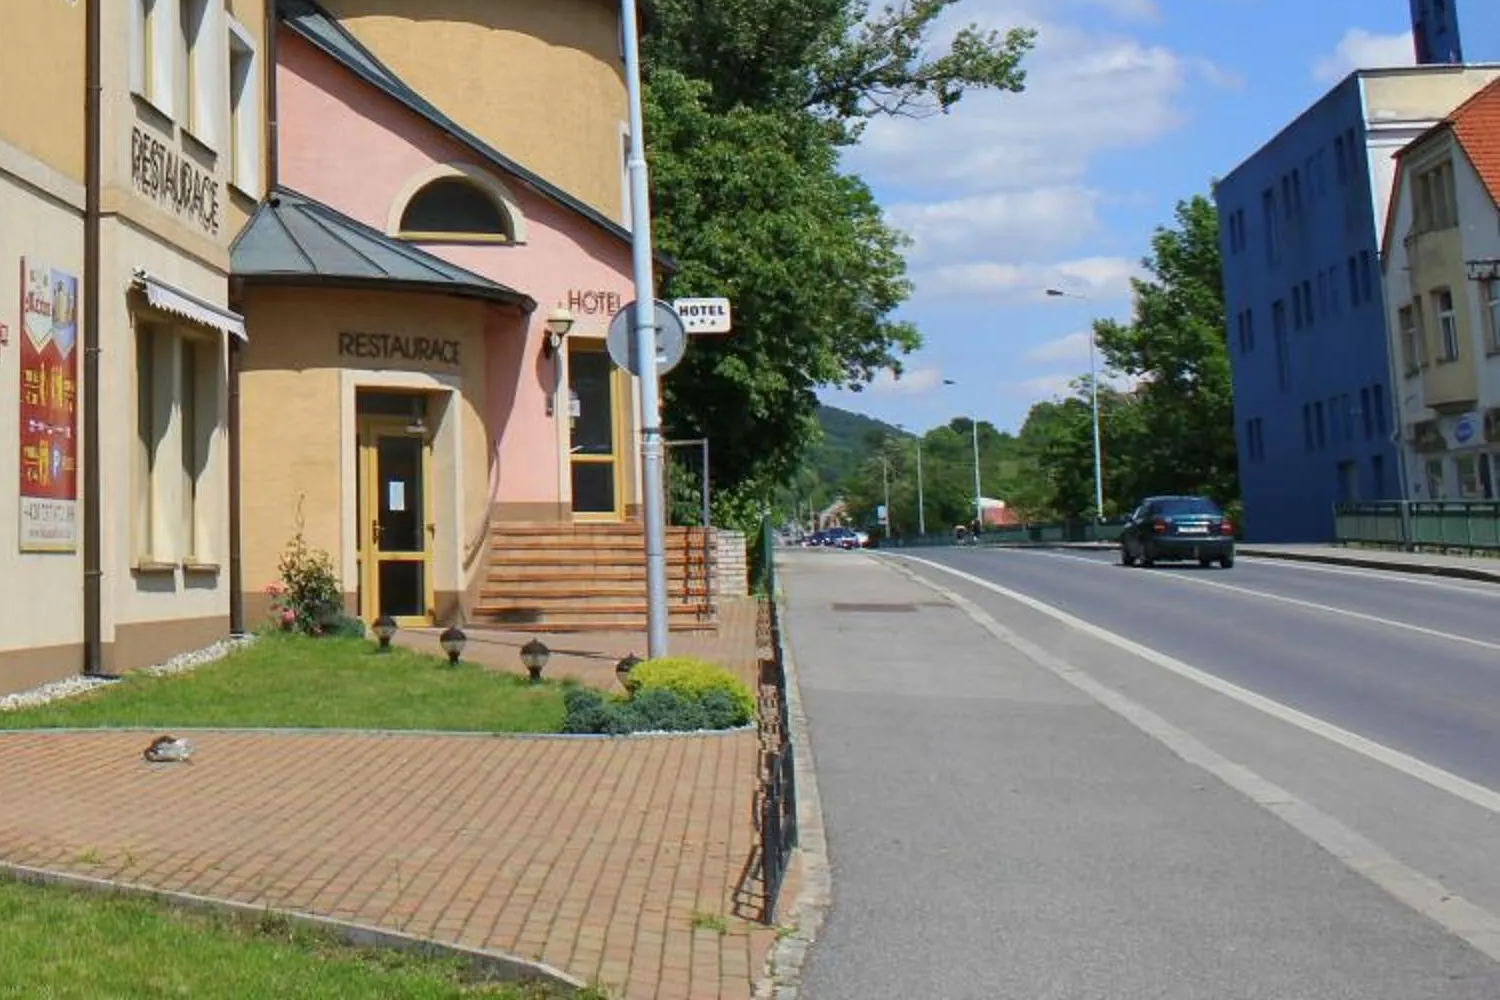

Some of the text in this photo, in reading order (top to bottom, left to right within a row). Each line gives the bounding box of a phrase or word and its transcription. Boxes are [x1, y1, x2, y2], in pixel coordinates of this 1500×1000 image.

[132, 126, 219, 231] RESTAURACE
[679, 305, 724, 317] HOTEL
[339, 332, 461, 365] RESTAURACE
